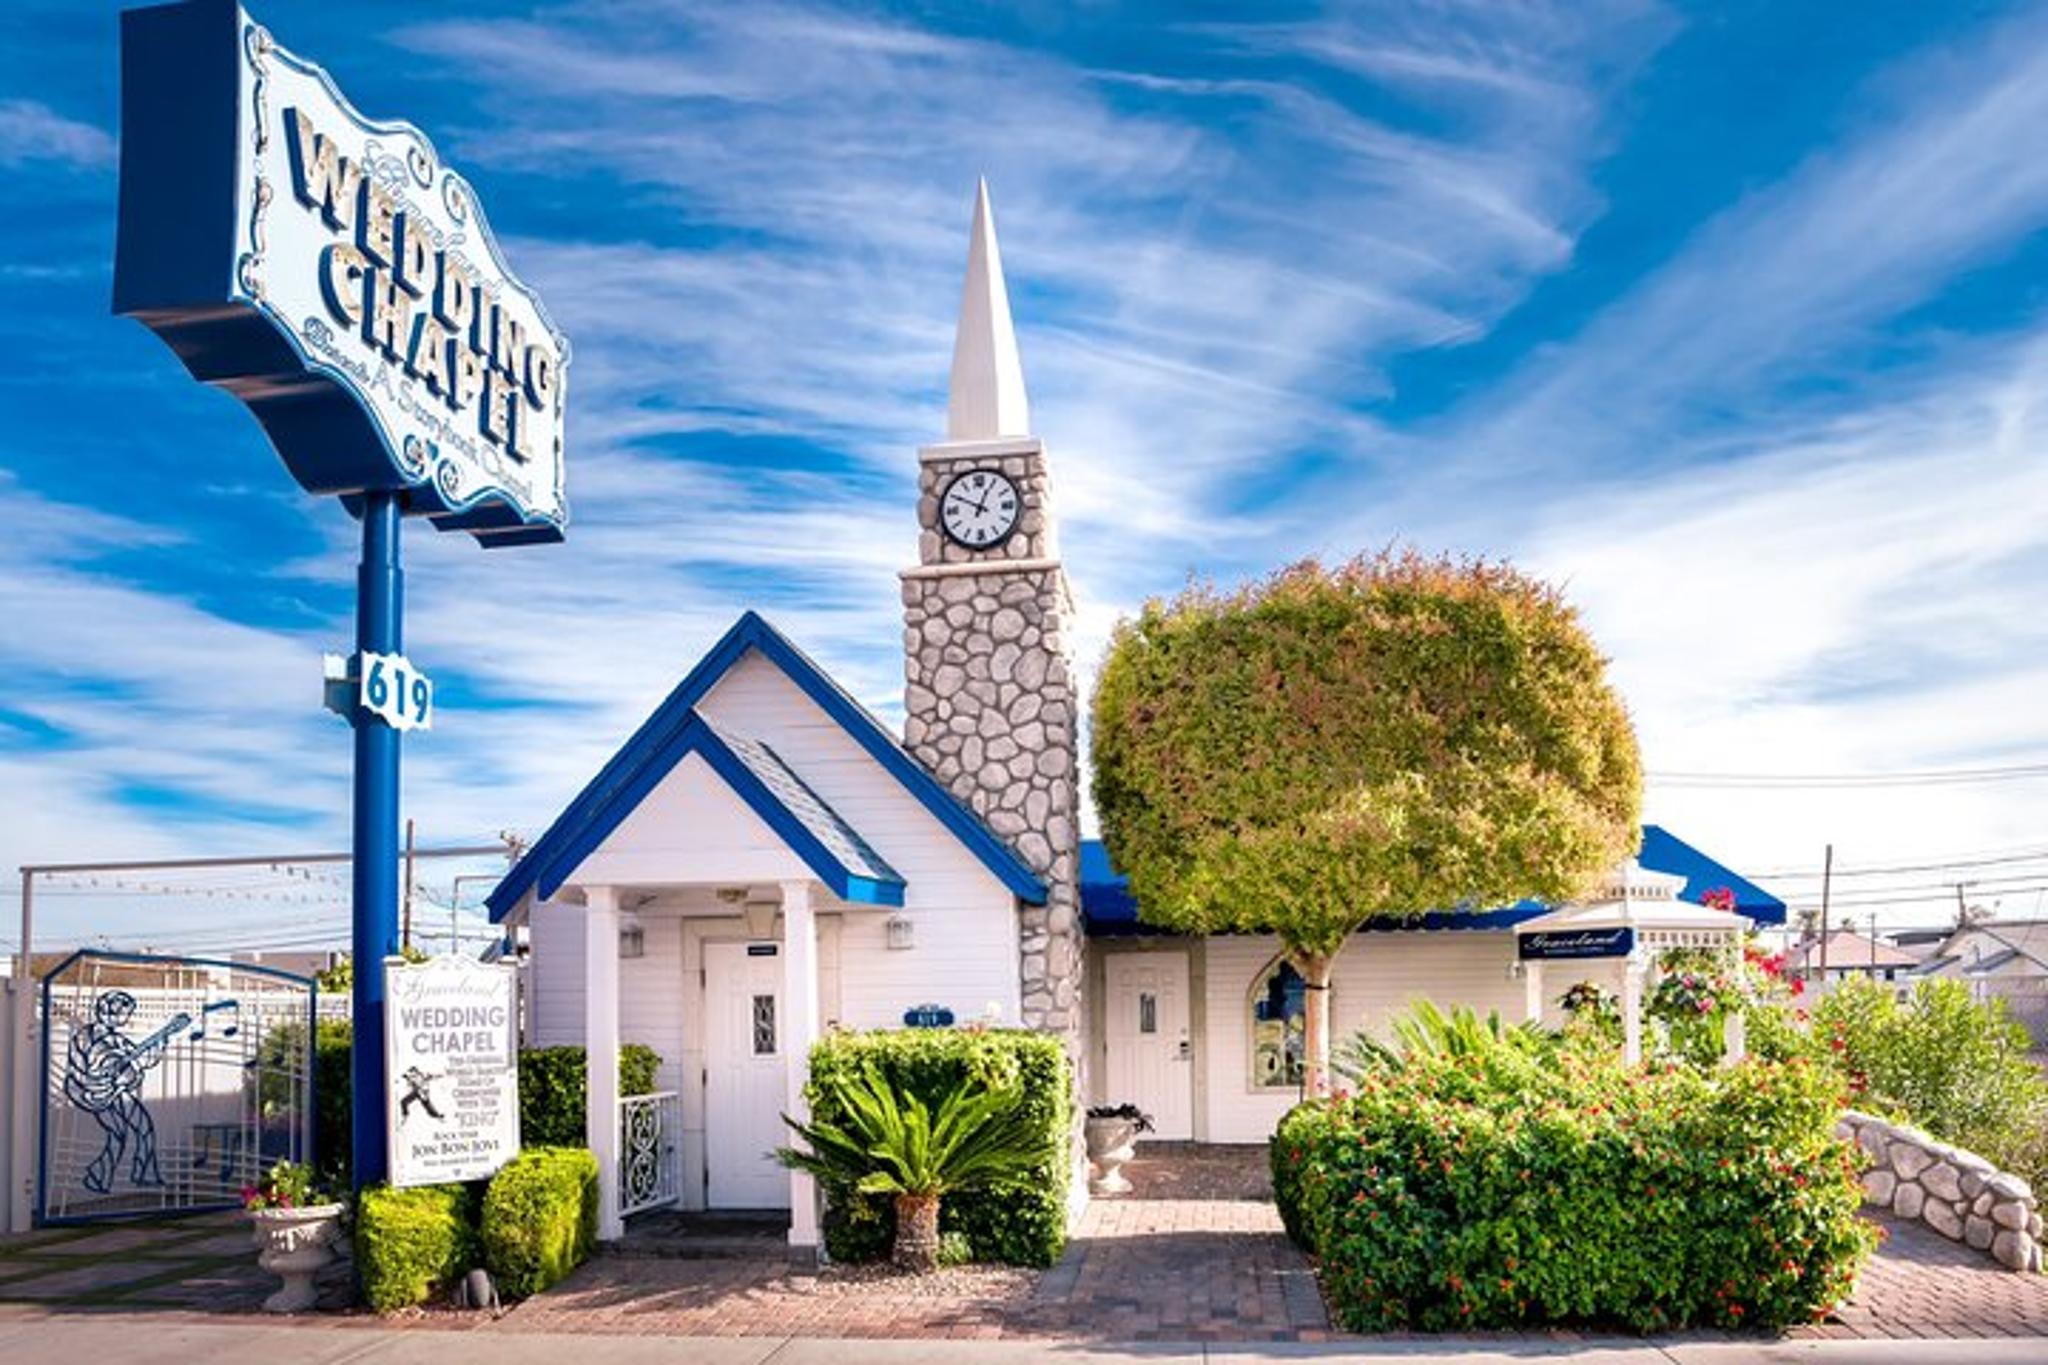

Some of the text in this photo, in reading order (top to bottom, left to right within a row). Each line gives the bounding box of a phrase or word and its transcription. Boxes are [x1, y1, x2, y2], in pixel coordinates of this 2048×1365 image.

[283, 107, 553, 412] WEDDING
[318, 242, 531, 465] CHAPEL
[367, 661, 427, 722] 619
[401, 1006, 505, 1029] WEDDING
[412, 1031, 496, 1054] CHAPEL
